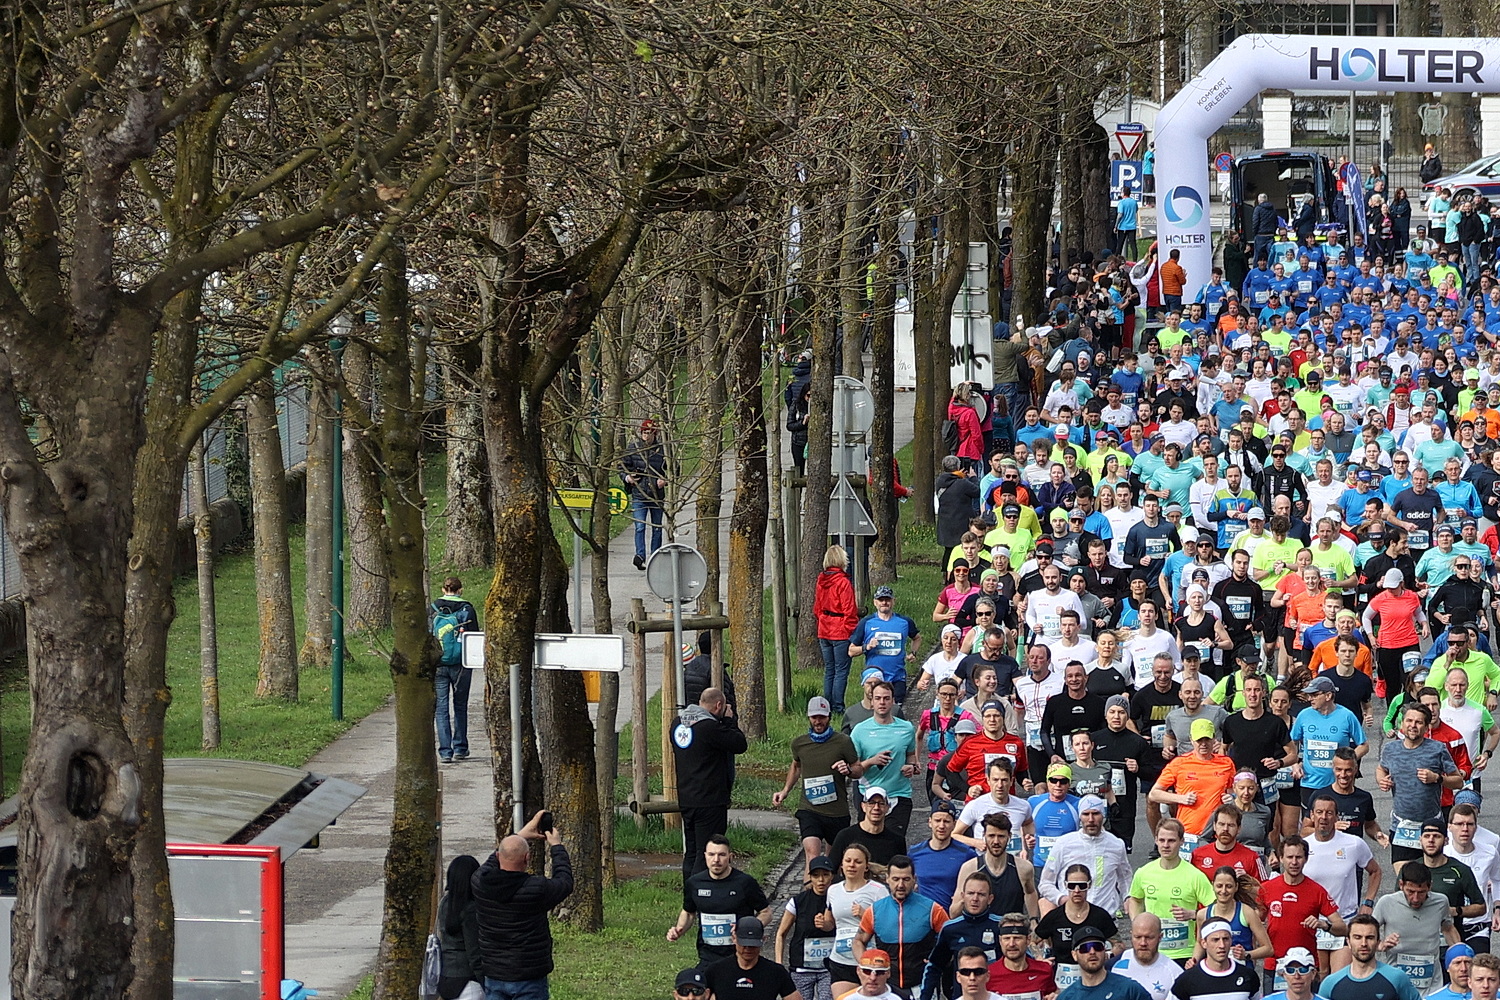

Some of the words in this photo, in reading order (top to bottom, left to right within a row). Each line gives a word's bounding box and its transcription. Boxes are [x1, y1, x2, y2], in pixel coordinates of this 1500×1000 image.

[1309, 46, 1485, 84] HOLTER
[1197, 77, 1227, 107] KOMFORT
[1204, 85, 1233, 112] ERLEBEN
[1165, 234, 1206, 245] HOLTER
[1406, 511, 1431, 519] adidas
[881, 639, 895, 648] 404
[1313, 750, 1330, 759] 358
[811, 785, 828, 796] 379
[1403, 828, 1416, 839] 32
[711, 925, 724, 935] 16
[1405, 966, 1425, 976] 249
